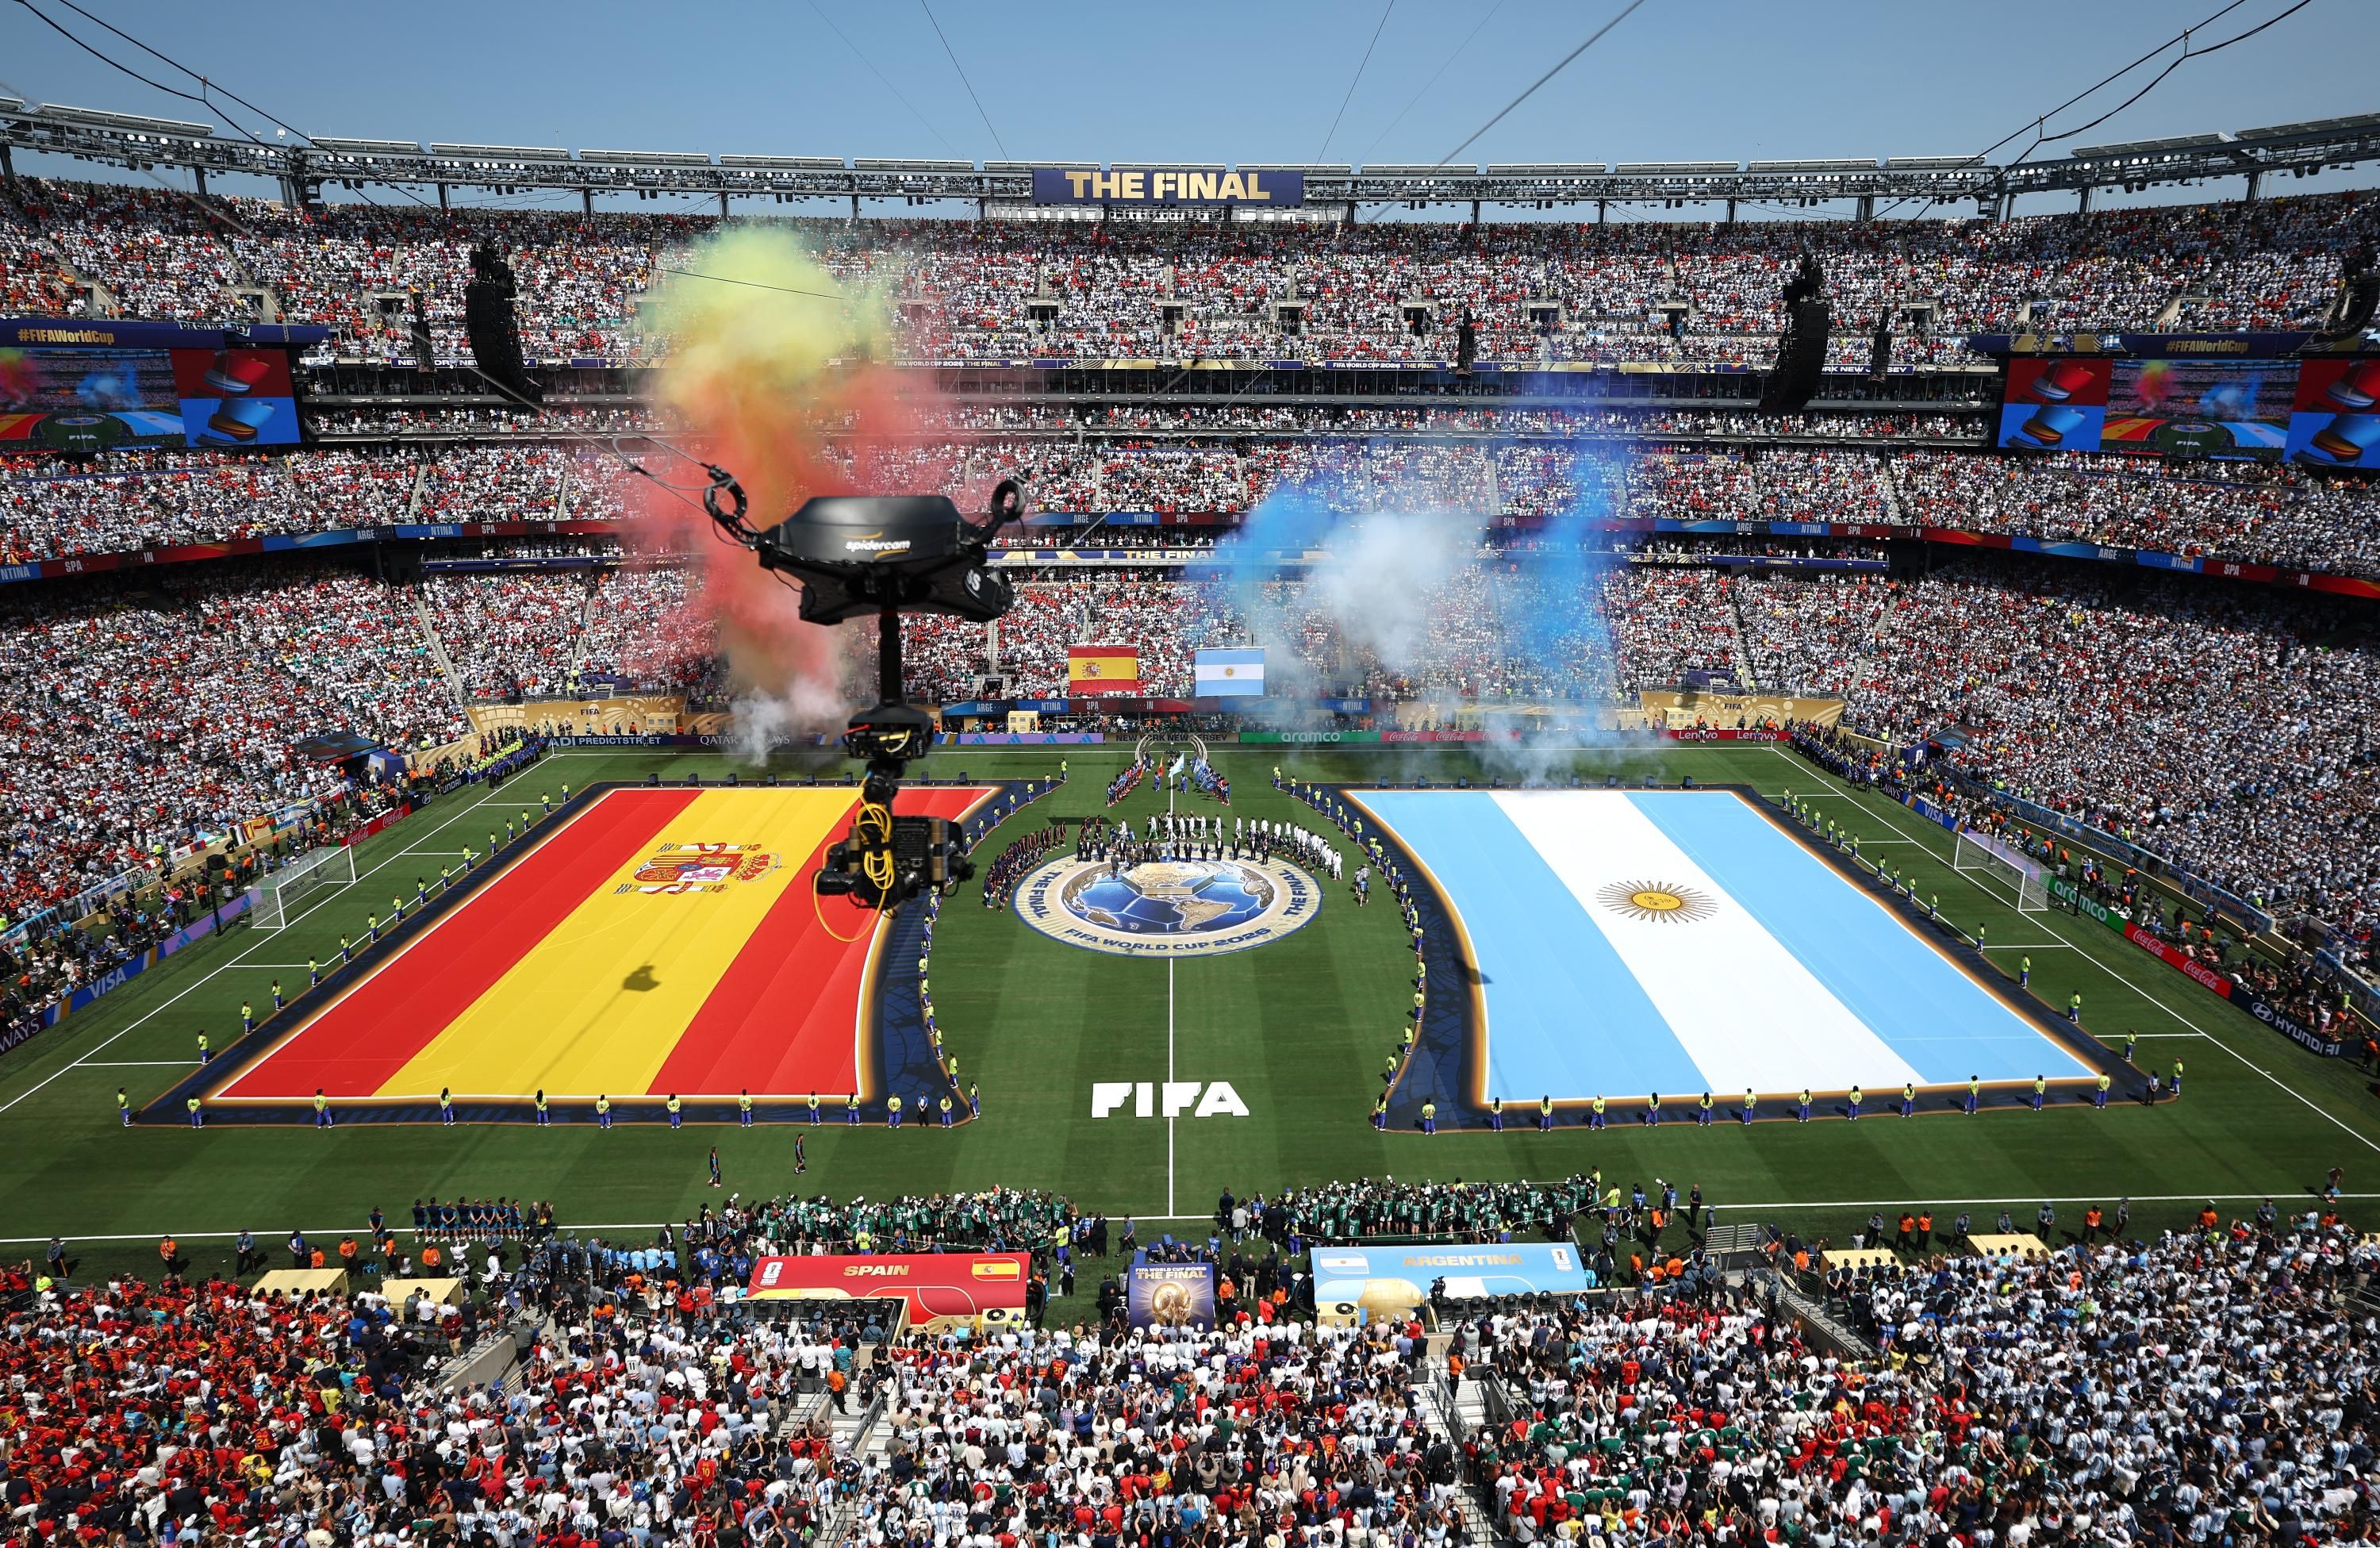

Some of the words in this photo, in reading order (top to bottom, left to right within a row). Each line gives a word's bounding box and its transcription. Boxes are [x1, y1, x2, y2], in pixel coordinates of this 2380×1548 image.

[1065, 171, 1144, 198] THE
[1152, 172, 1270, 200] FINAL
[17, 328, 114, 344] #FIFAWorldCup
[2165, 340, 2249, 354] #FIFAWorldCup
[1073, 514, 1089, 524] ARGE
[1134, 514, 1152, 524] NTINA
[1176, 514, 1188, 524] SPA
[431, 525, 453, 536] NTINA
[482, 525, 496, 534] SPA
[547, 523, 555, 532] IN
[1736, 522, 1752, 532] ARGE
[1801, 525, 1821, 534] NTINA
[1847, 526, 1860, 535] SPA
[357, 528, 375, 540] ARGE
[844, 539, 911, 552] spidercam
[144, 551, 154, 563] IN
[2098, 548, 2117, 560] ARGE
[65, 559, 83, 573] SPA
[2224, 563, 2240, 576] SPA
[1, 566, 30, 580] NTINA
[2299, 574, 2309, 586] IN
[977, 701, 993, 713] ARGE
[1042, 701, 1061, 711] NTINA
[1086, 701, 1099, 711] SPA
[1146, 701, 1154, 710] IN
[1342, 701, 1362, 711] NTINA
[700, 736, 738, 745] QATAR
[1281, 732, 1341, 743] aramco
[1924, 805, 1944, 825] VISA
[1033, 871, 1063, 888] THE
[1278, 870, 1307, 896] FINAL
[1029, 889, 1050, 919] FINAL
[1282, 897, 1307, 915] THE
[2053, 880, 2108, 923] aramco
[1065, 928, 1098, 943] FIFA
[1103, 938, 1169, 951] WORLD
[1212, 927, 1271, 947] 2026
[89, 968, 126, 998] VISA
[1092, 1081, 1250, 1118] FIFA
[1403, 1254, 1524, 1267] ARGENTINA
[843, 1264, 910, 1277] SPAIN
[1135, 1271, 1163, 1280] THE
[989, 1352, 997, 1361] 10
[628, 1362, 635, 1370] 11
[1053, 1367, 1063, 1376] 20
[1307, 1424, 1315, 1433] 10
[256, 1439, 270, 1448] 24
[1280, 1462, 1289, 1470] 10
[701, 1467, 711, 1477] 10
